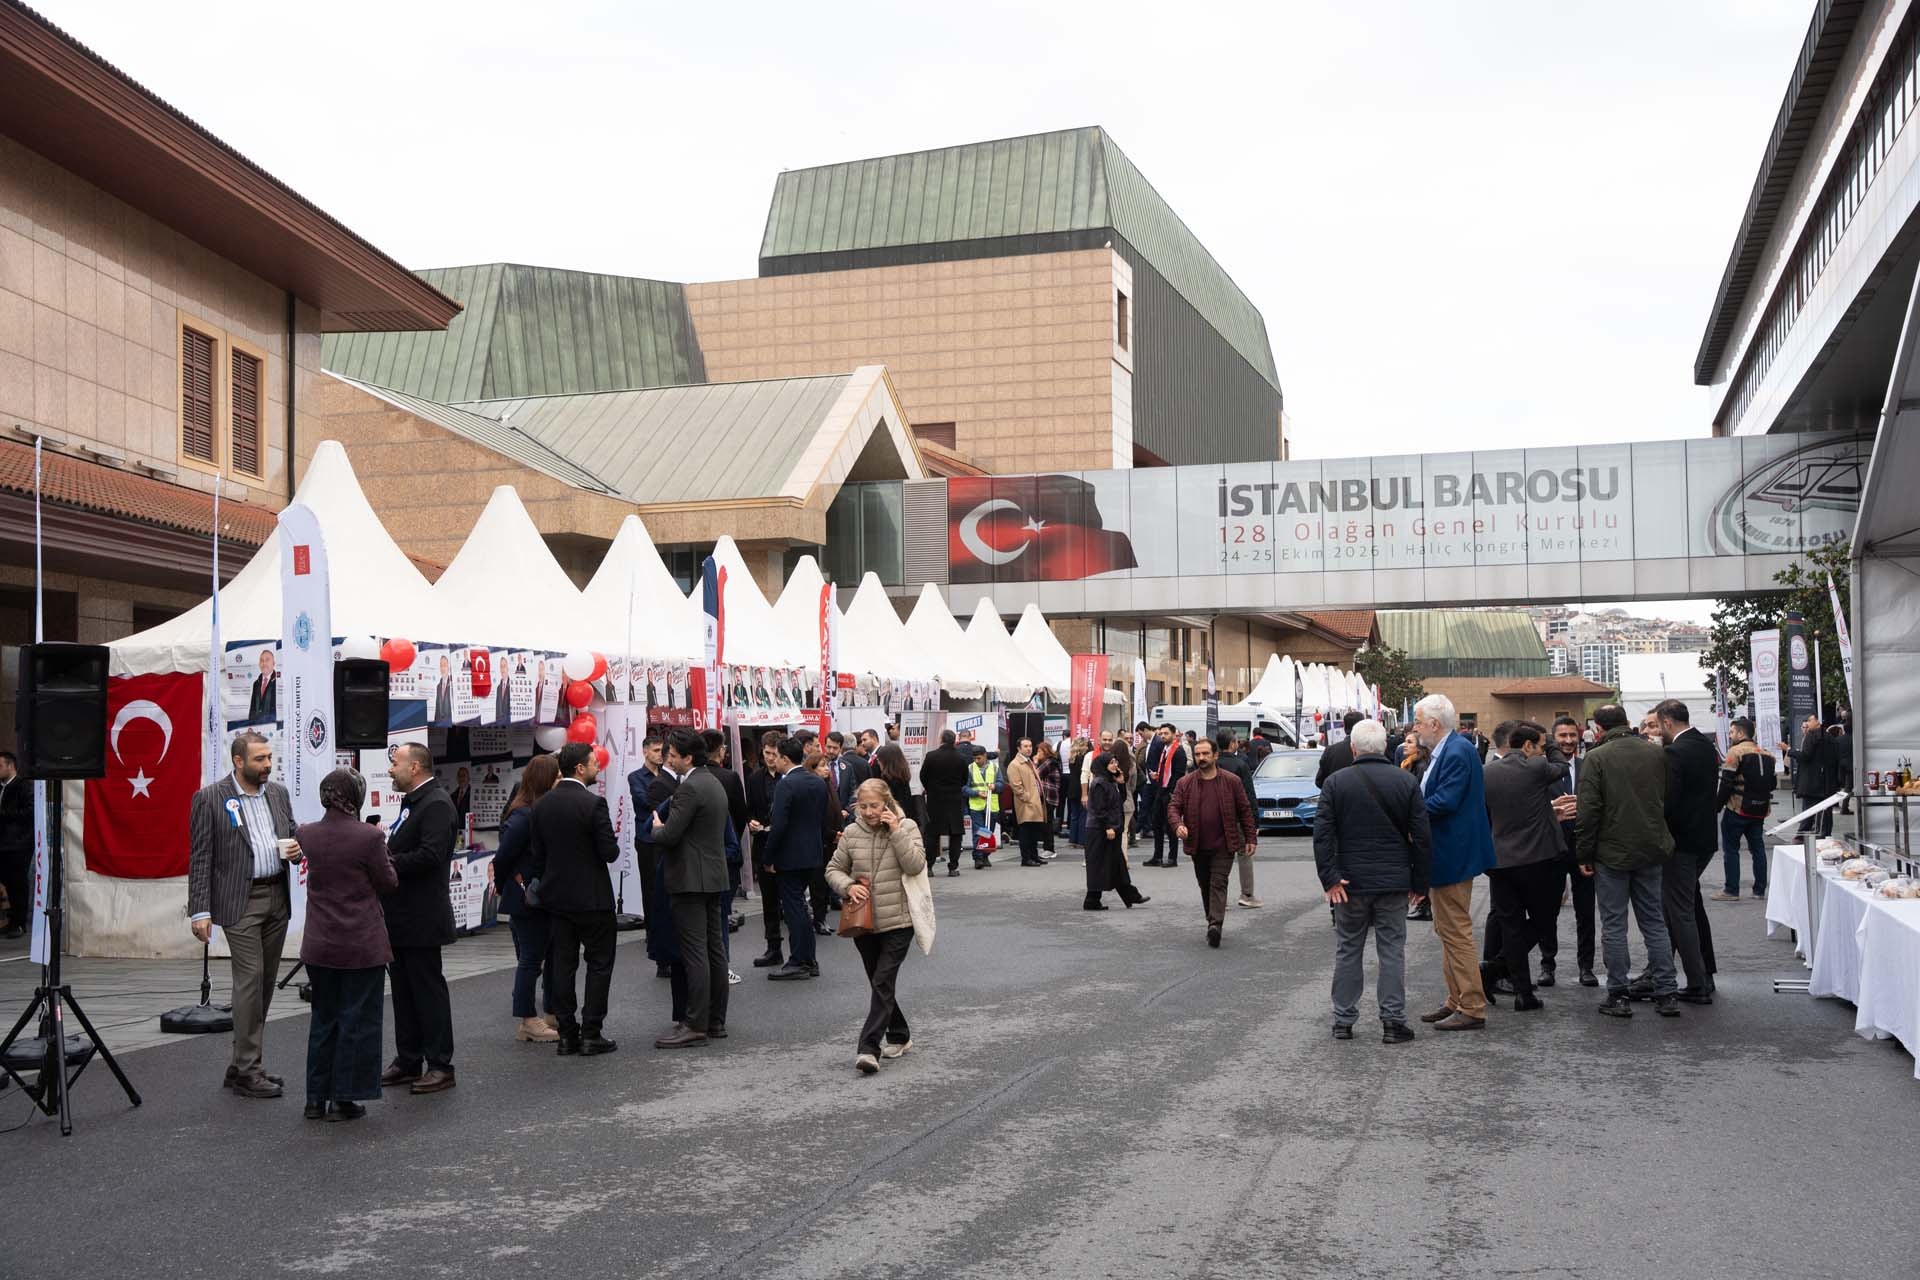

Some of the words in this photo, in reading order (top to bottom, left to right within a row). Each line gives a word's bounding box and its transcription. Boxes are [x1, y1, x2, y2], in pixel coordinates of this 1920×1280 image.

[1218, 476, 1424, 517] İSTANBUL
[1433, 467, 1619, 507] BAROSU
[1220, 524, 1276, 545] 128.
[1295, 520, 1394, 544] Olağan
[1412, 514, 1496, 536] Genel
[1516, 509, 1618, 532] Kurulu
[1220, 550, 1273, 563] 24-25
[1281, 545, 1324, 561] Ekim
[1405, 540, 1452, 557] Haliç
[1463, 539, 1529, 555] Kongre
[1541, 535, 1618, 551] Merkezi
[904, 726, 928, 737] AVUKAT
